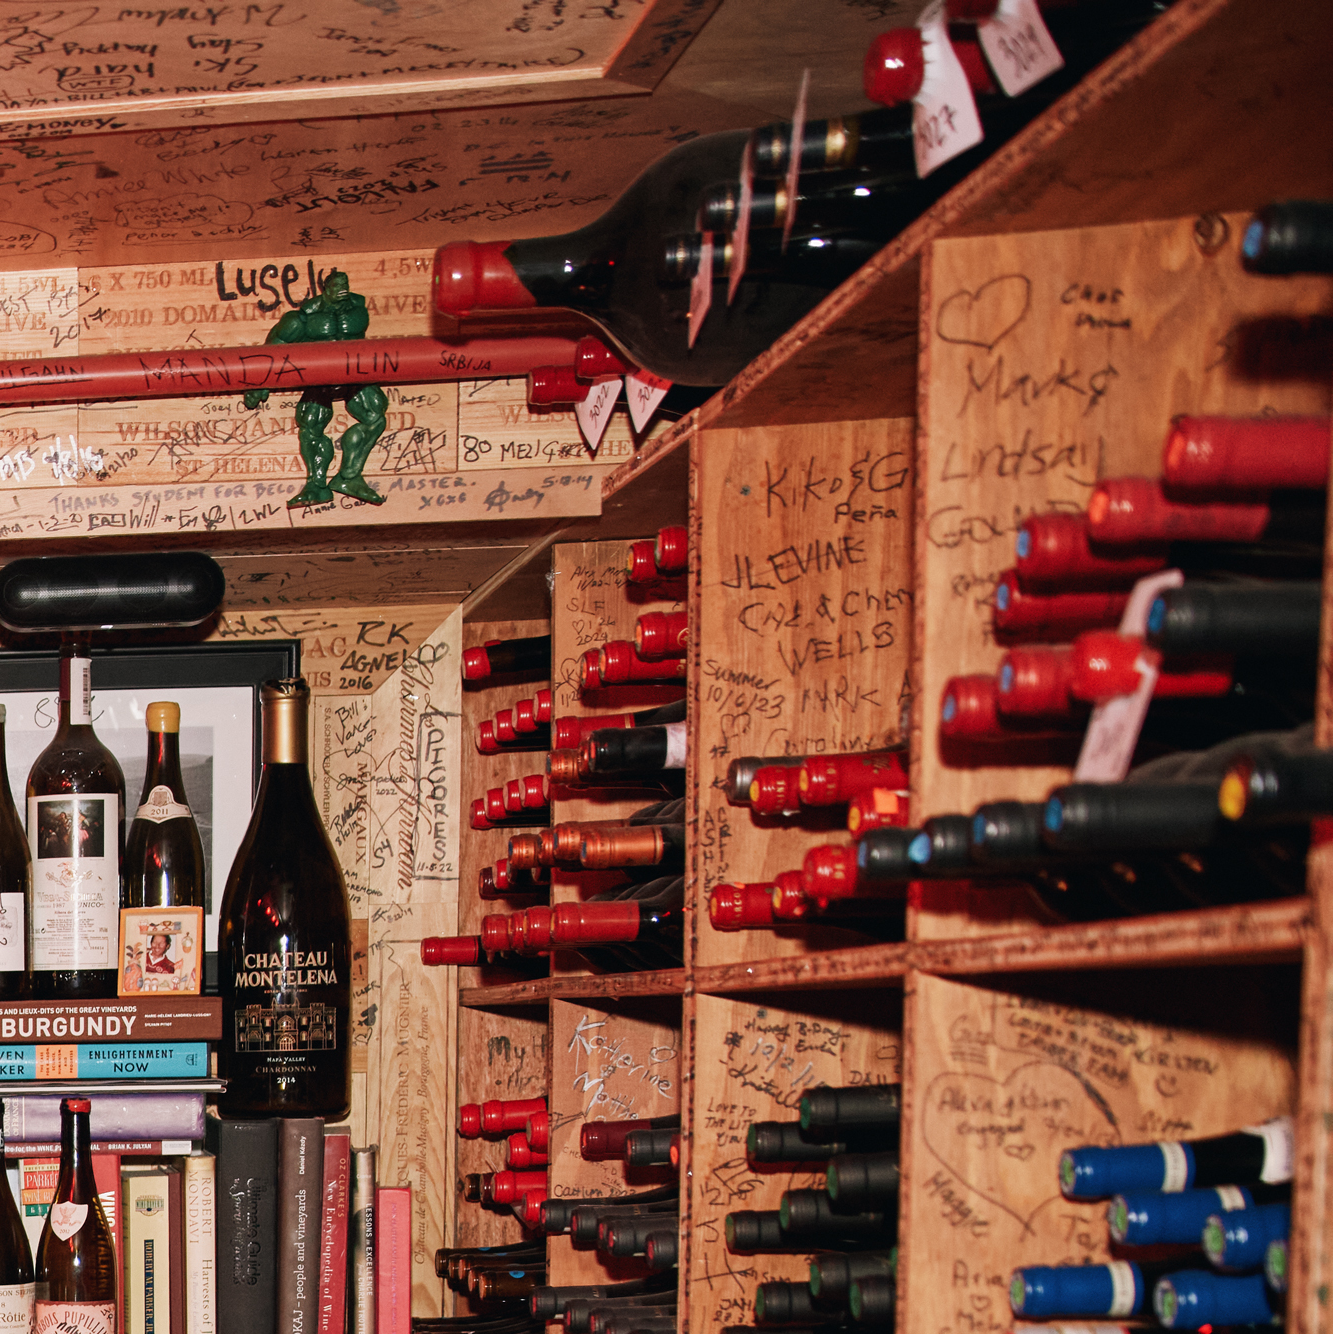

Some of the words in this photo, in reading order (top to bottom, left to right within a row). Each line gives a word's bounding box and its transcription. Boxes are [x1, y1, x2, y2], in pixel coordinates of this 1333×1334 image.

[133, 269, 171, 288] 750
[178, 267, 215, 286] ML
[139, 353, 307, 390] MANDA
[244, 951, 328, 970] CHATEAU
[234, 969, 338, 988] MONTELENA
[19, 1007, 54, 1015] LIEUX-DITS
[79, 1006, 100, 1014] GREAT
[2, 1015, 137, 1038] BURGUNDY
[88, 1049, 174, 1060] ENLIGHTENMENT
[113, 1062, 149, 1073] NOW
[327, 1179, 337, 1204] New
[188, 1171, 200, 1245] MONDAVI
[202, 1176, 213, 1237] ROBERT
[294, 1189, 308, 1230] vineyards
[365, 1203, 373, 1238] LESSONS
[296, 1232, 306, 1254] and
[323, 1206, 336, 1284] Encyclopedia
[201, 1259, 213, 1303] Harvests
[296, 1258, 308, 1300] people
[365, 1246, 374, 1297] EXCELLENCE
[322, 1304, 332, 1332] Wine
